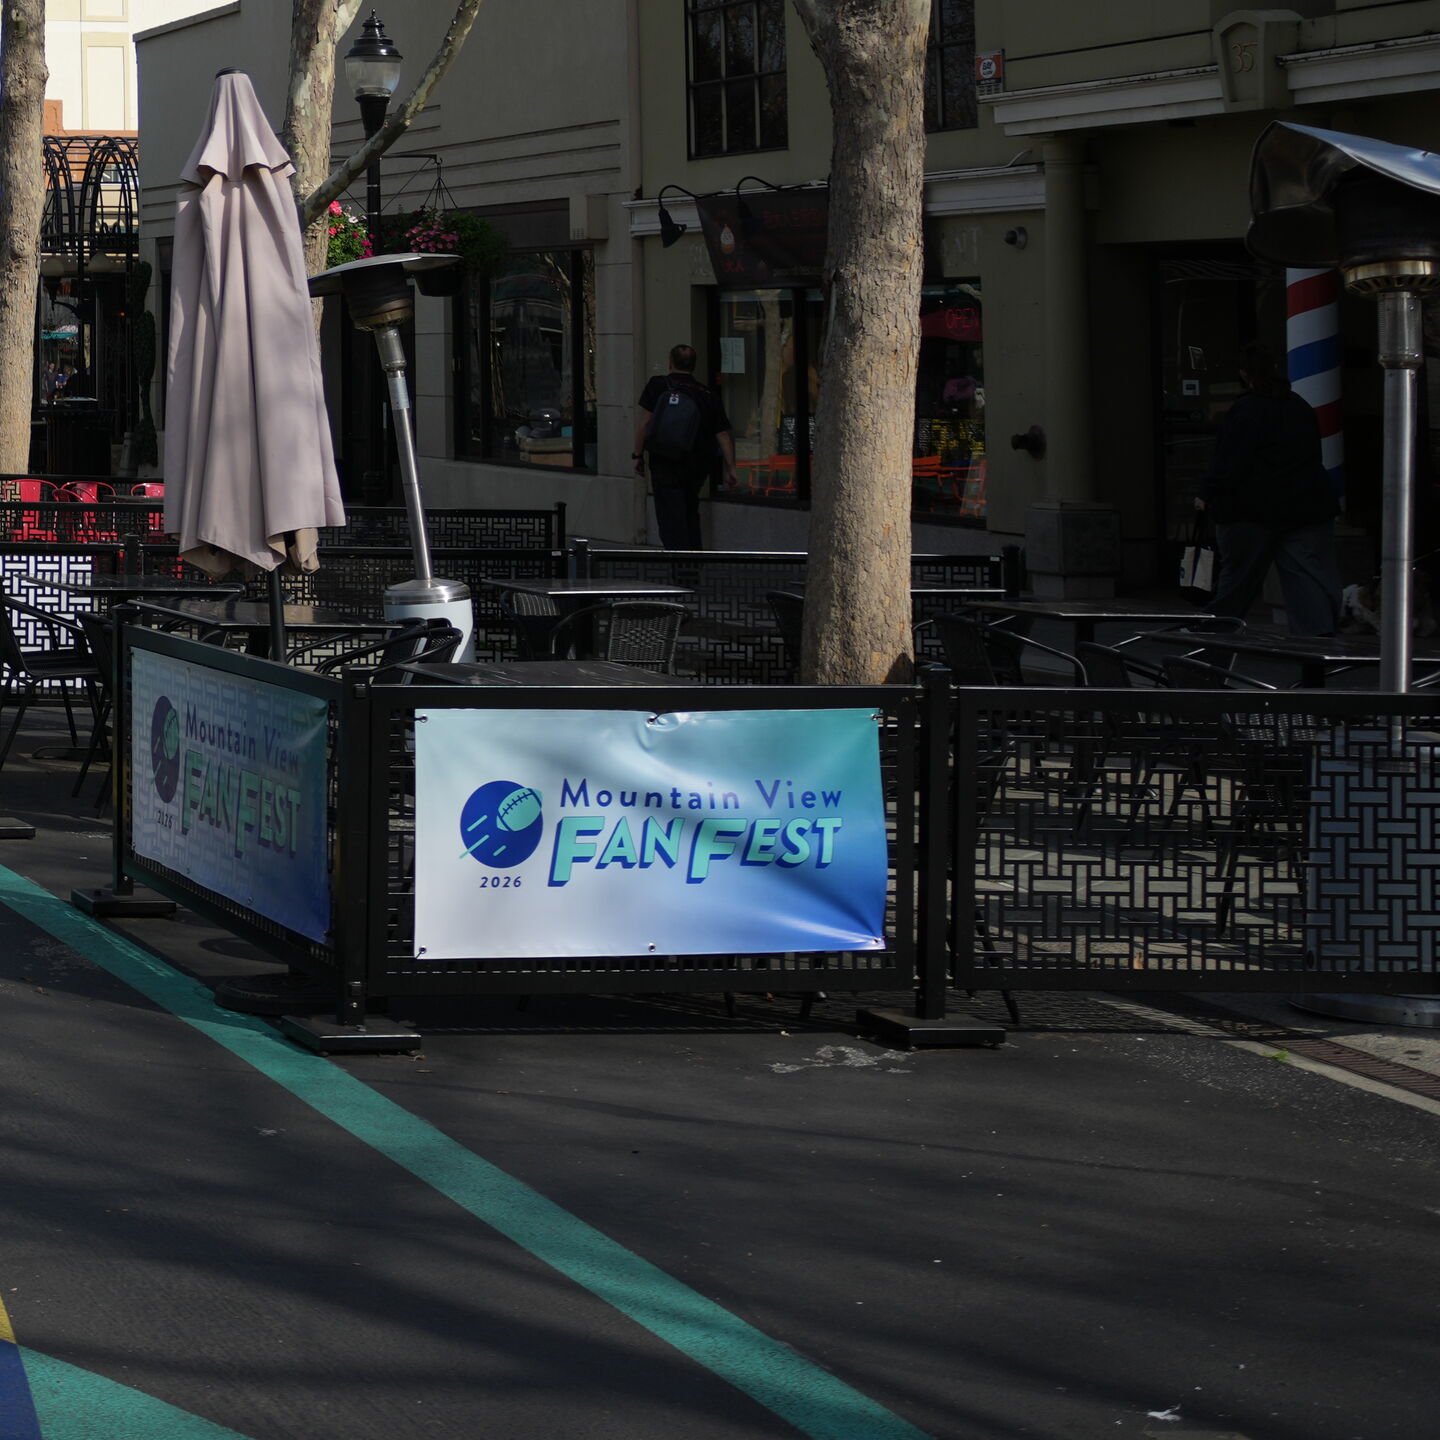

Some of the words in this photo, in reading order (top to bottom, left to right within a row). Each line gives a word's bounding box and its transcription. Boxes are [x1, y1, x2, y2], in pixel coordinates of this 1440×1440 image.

[185, 700, 257, 760] Mountain
[263, 725, 300, 773] View
[559, 777, 740, 810] Mountain
[754, 779, 843, 809] View
[479, 875, 523, 889] 2026
